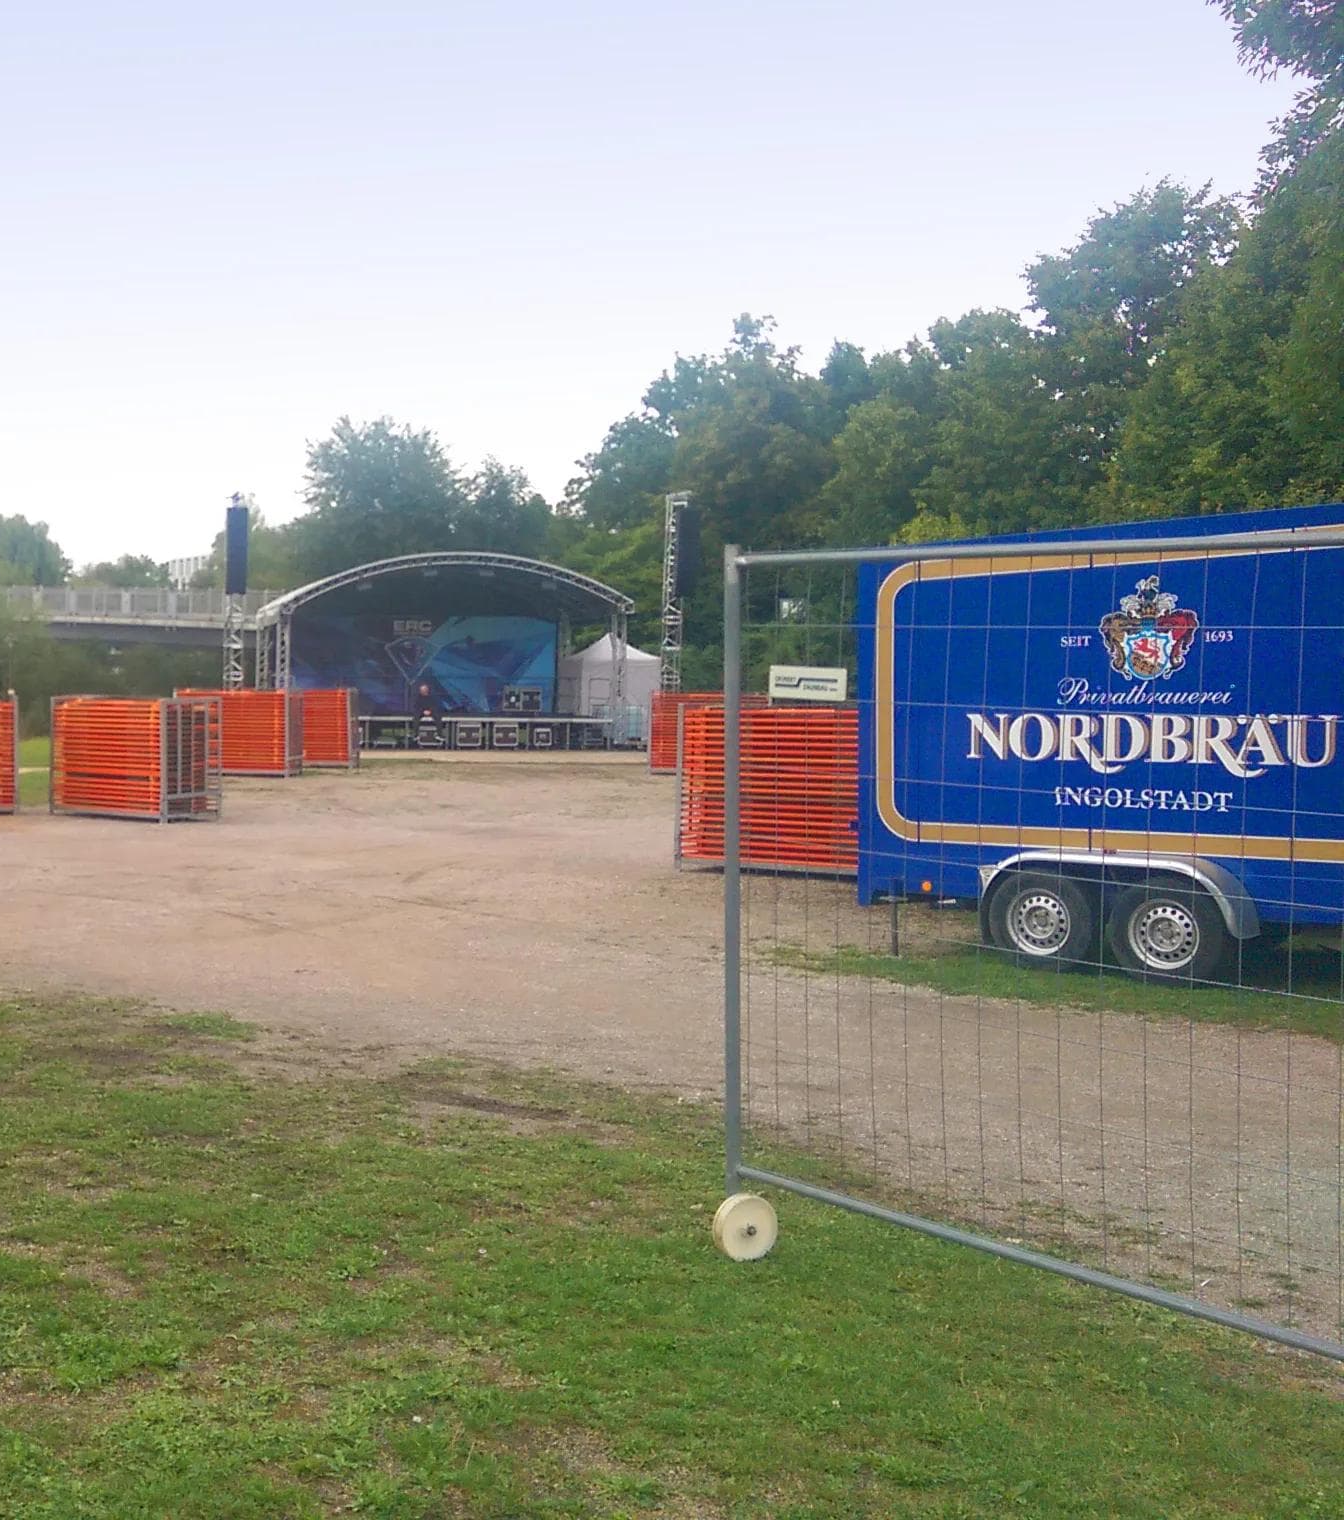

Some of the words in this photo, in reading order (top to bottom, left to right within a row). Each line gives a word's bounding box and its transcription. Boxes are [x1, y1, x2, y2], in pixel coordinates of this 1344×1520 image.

[1060, 634, 1091, 648] SEIT
[1204, 630, 1233, 643] 1693
[1057, 676, 1236, 705] Privatbrauerei
[966, 711, 1339, 779] NORDBRÄU
[1055, 786, 1234, 813] INGOLSTADT
